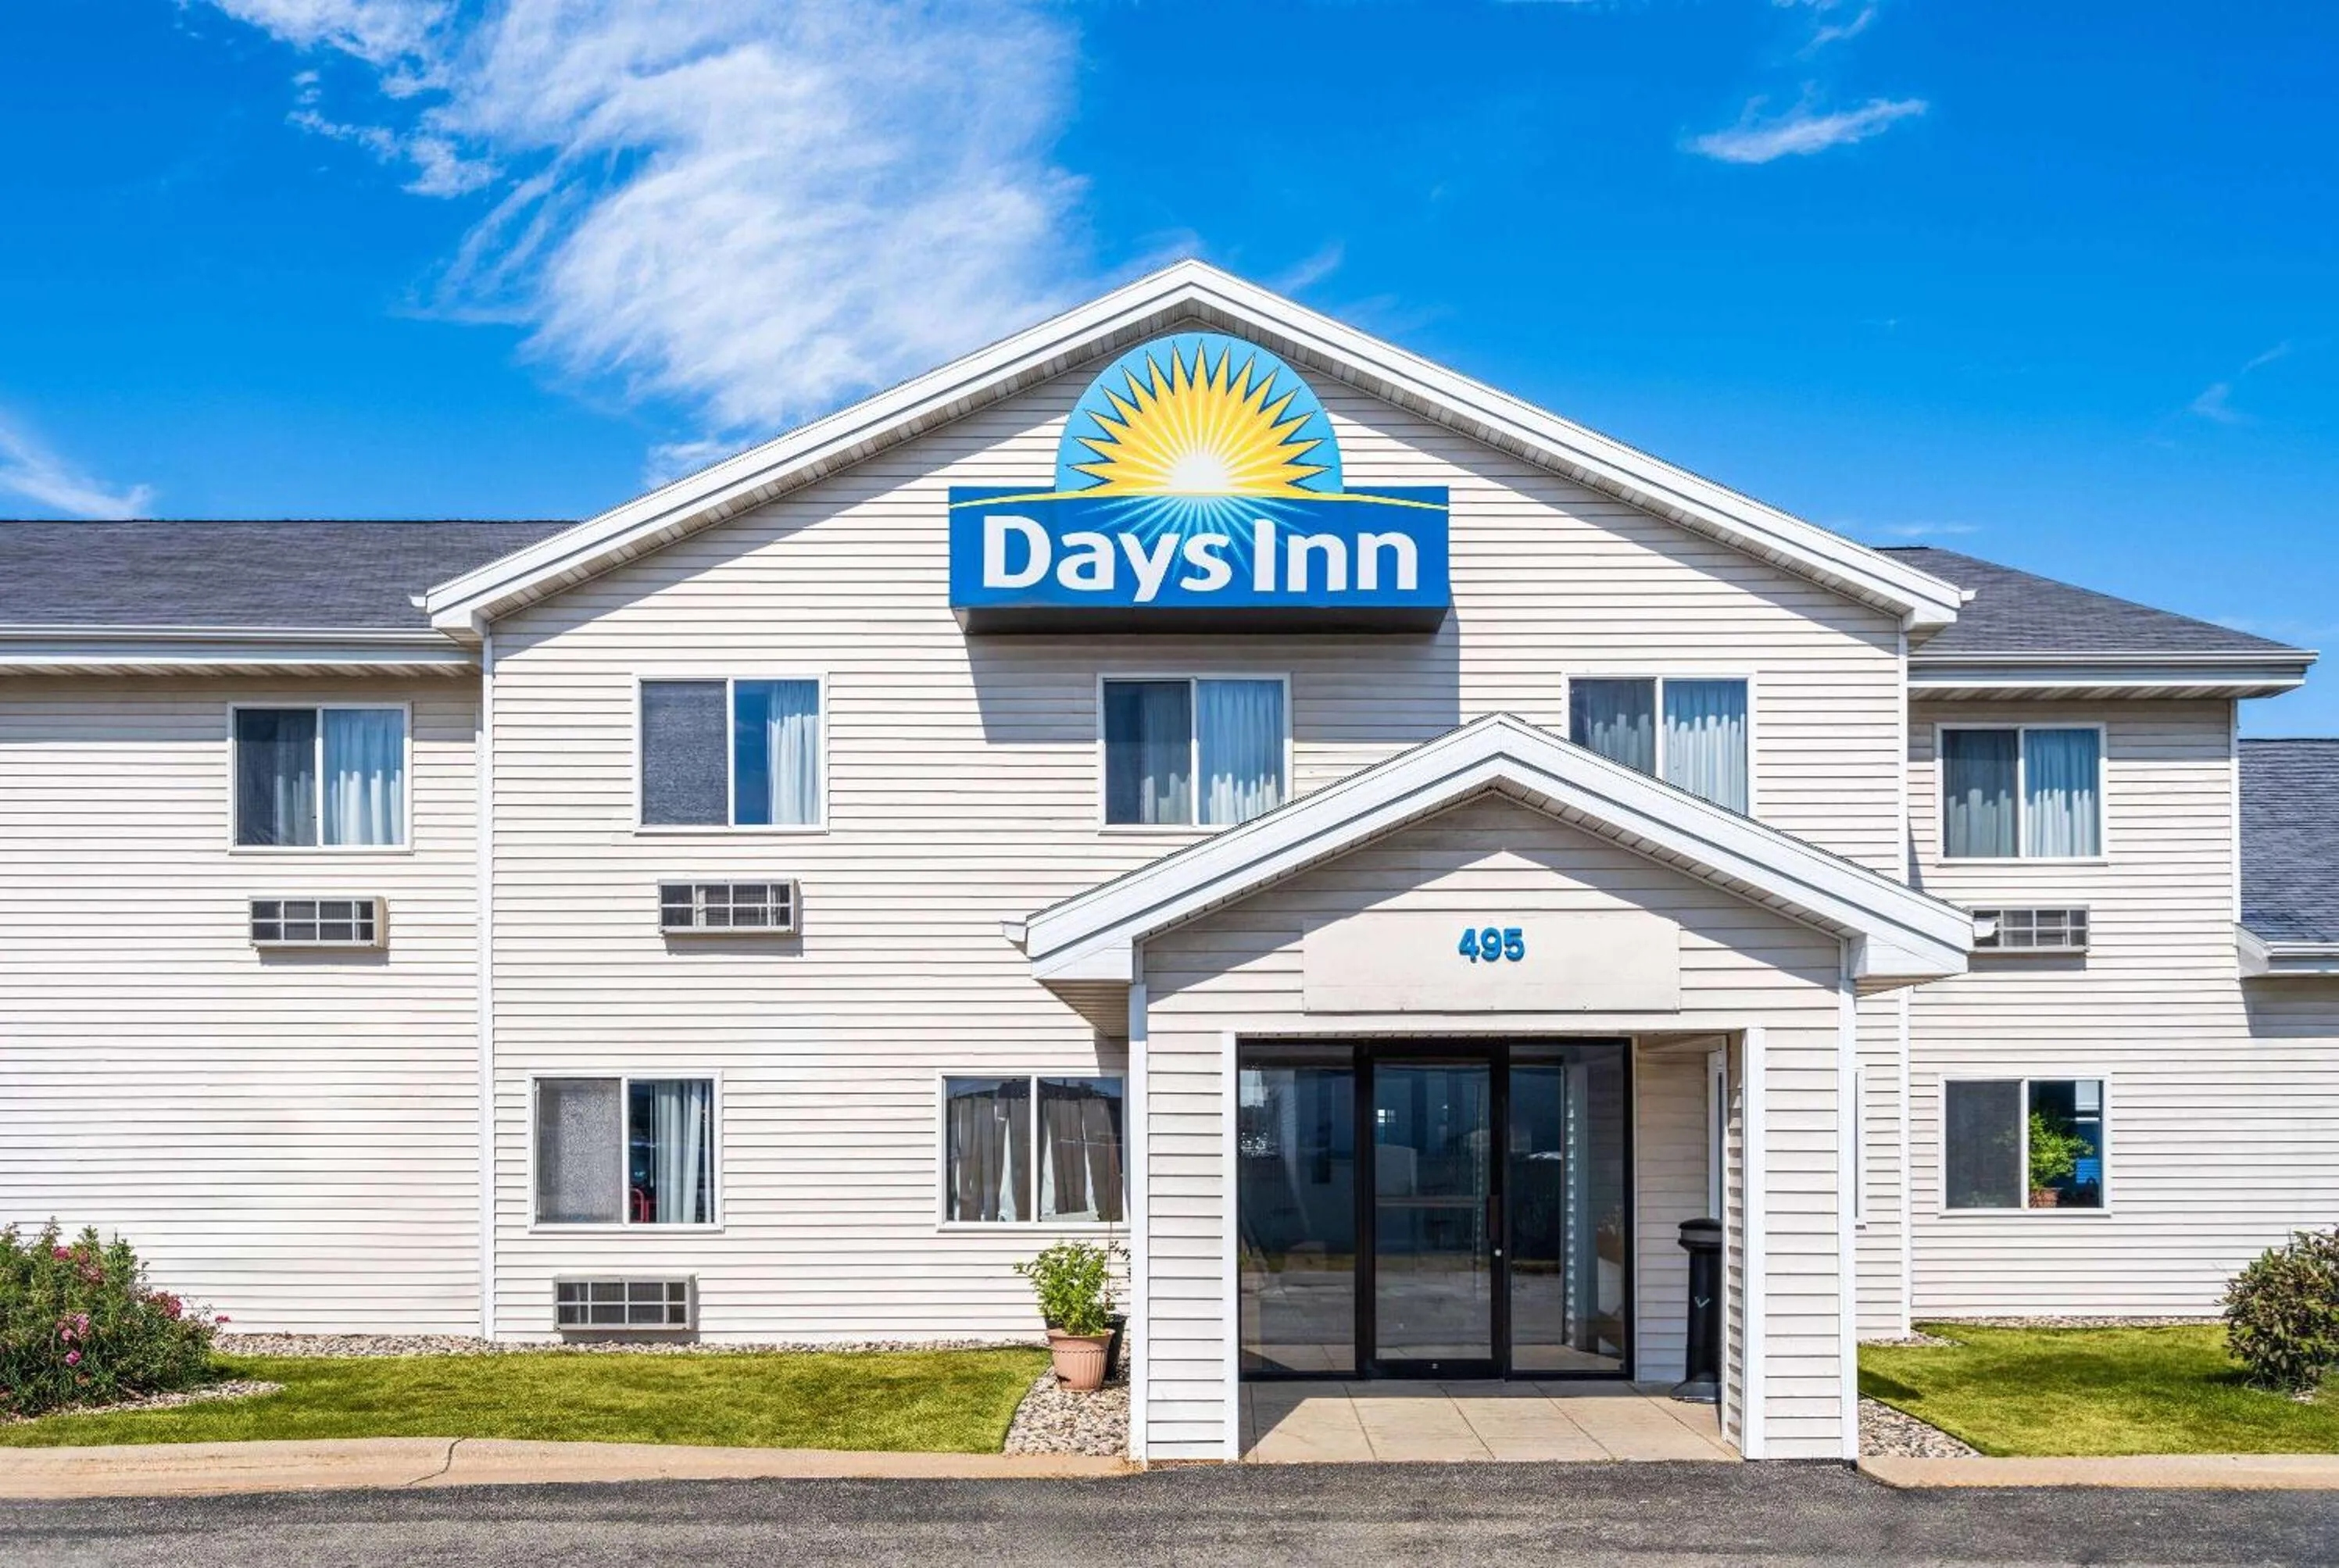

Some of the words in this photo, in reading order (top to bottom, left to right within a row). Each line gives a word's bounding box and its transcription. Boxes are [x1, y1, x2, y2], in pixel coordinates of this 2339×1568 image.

[982, 515, 1232, 602] Days
[1253, 519, 1418, 593] Inn
[1458, 927, 1525, 963] 495
